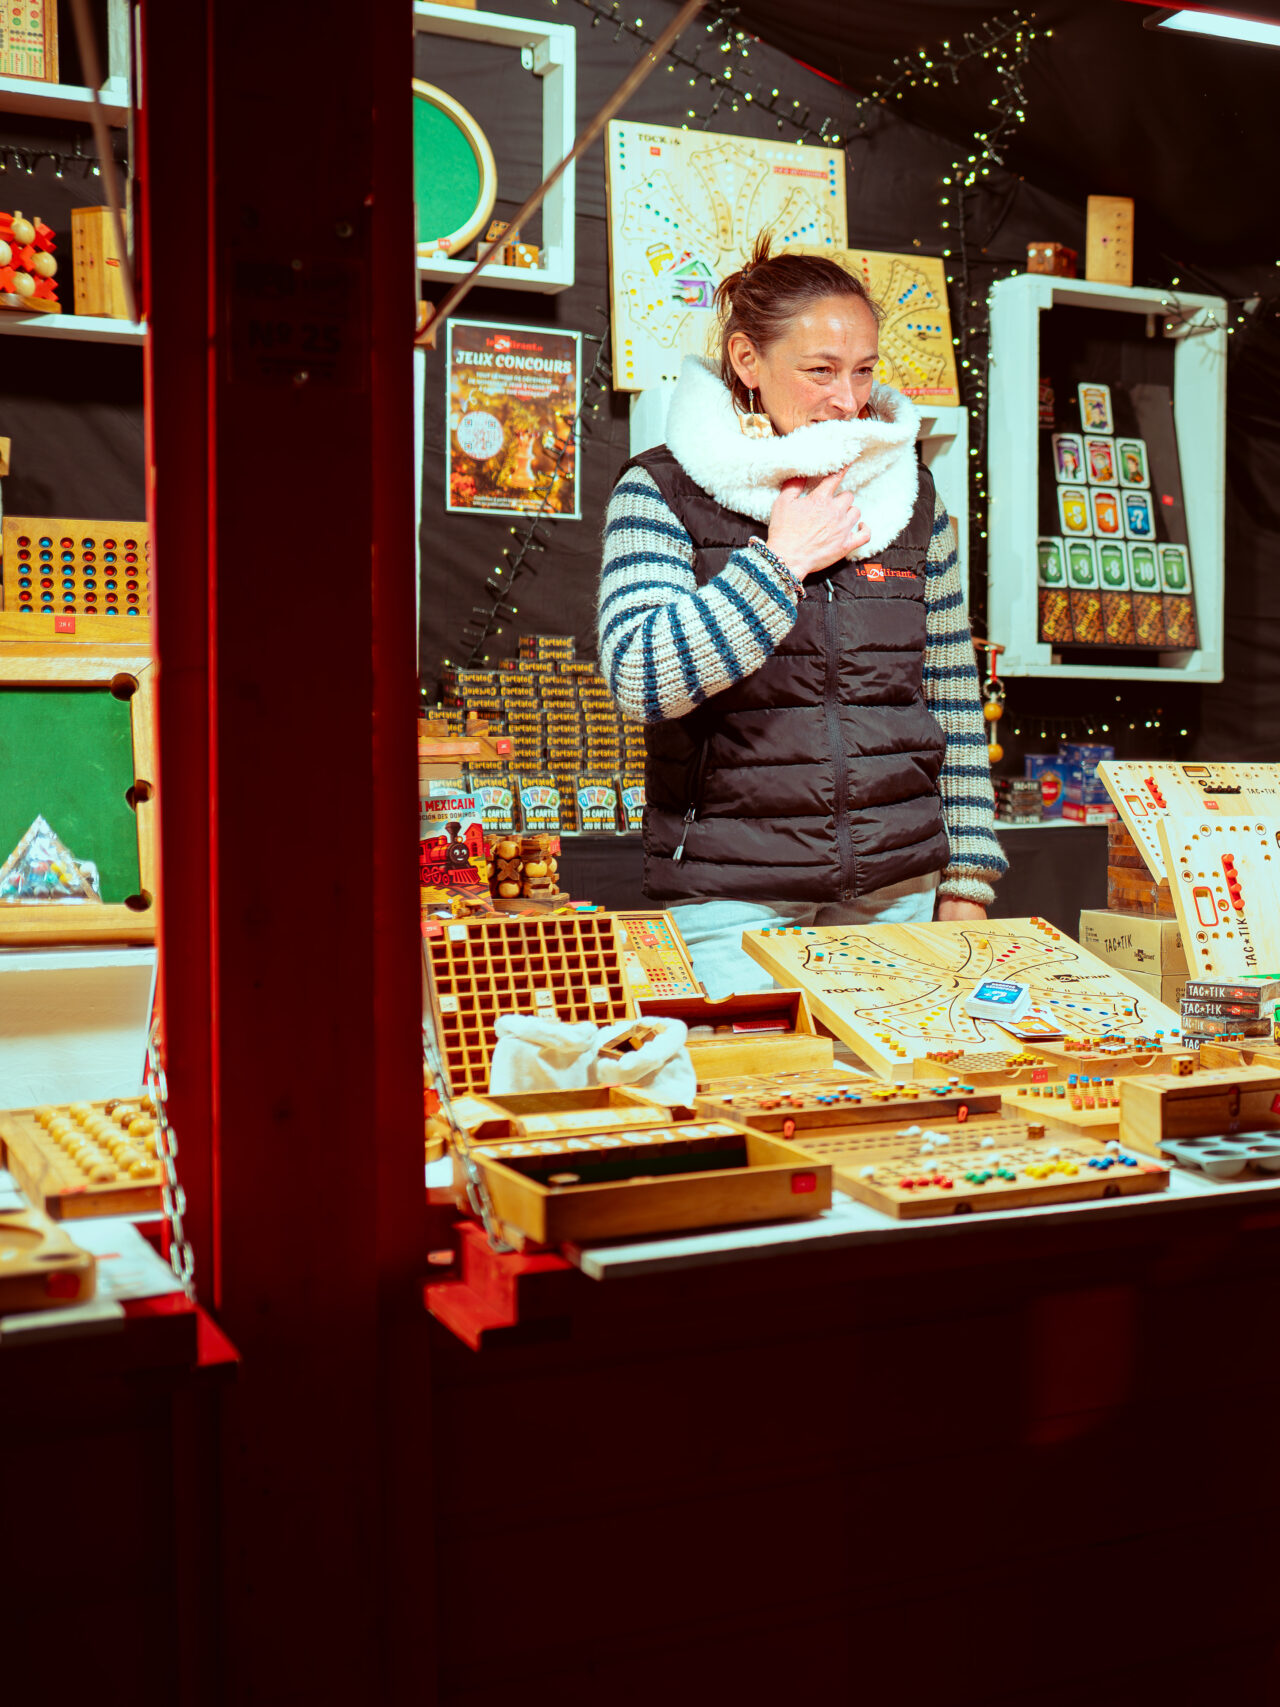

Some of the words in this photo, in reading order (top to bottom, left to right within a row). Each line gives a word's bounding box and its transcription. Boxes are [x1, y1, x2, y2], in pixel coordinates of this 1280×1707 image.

[303, 323, 342, 352] 25
[455, 350, 494, 367] JEUX
[494, 354, 572, 375] CONCOURS
[425, 797, 476, 813] MEXICAIN
